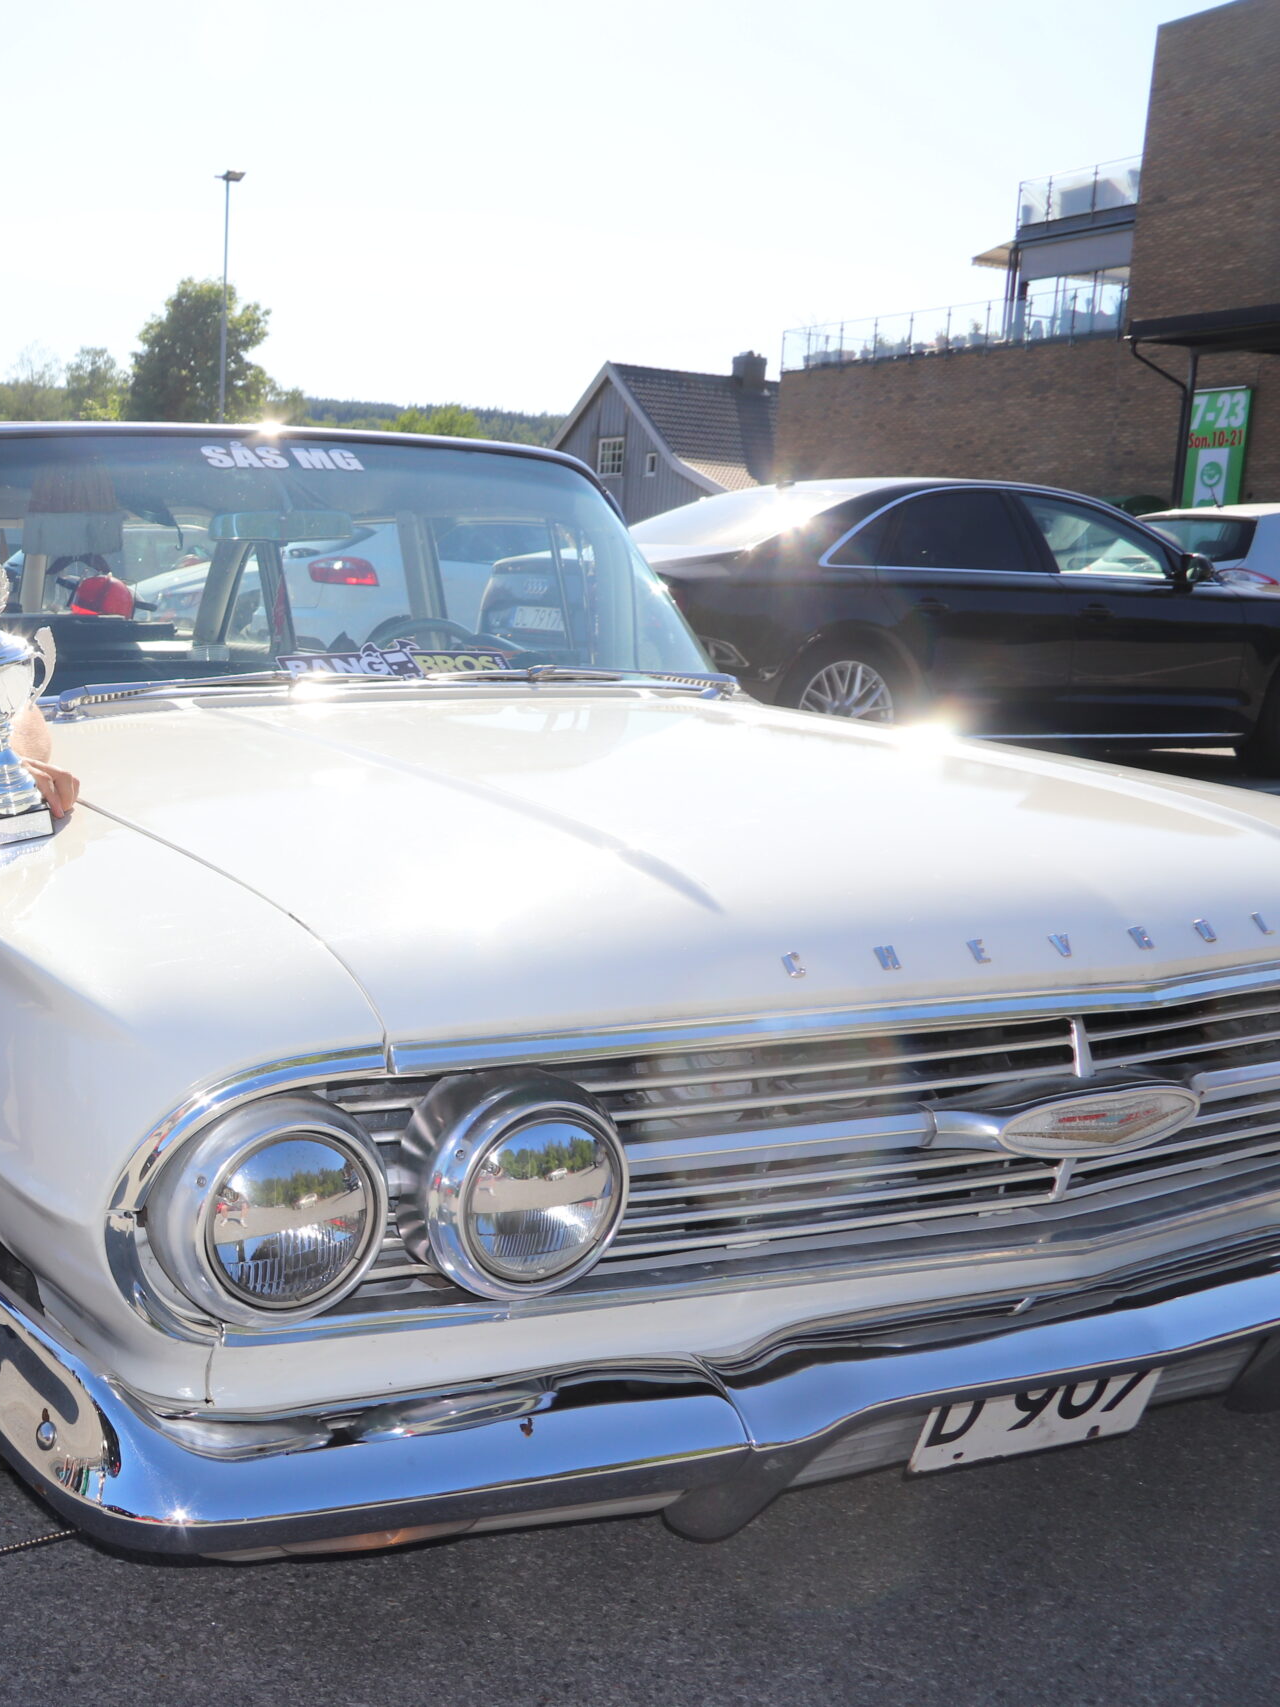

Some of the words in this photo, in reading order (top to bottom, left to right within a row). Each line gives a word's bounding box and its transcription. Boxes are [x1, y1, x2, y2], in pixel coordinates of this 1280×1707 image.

[1191, 392, 1246, 430] 7-23
[200, 441, 290, 469] SÅS
[289, 447, 365, 471] MG
[413, 655, 498, 673] BROS
